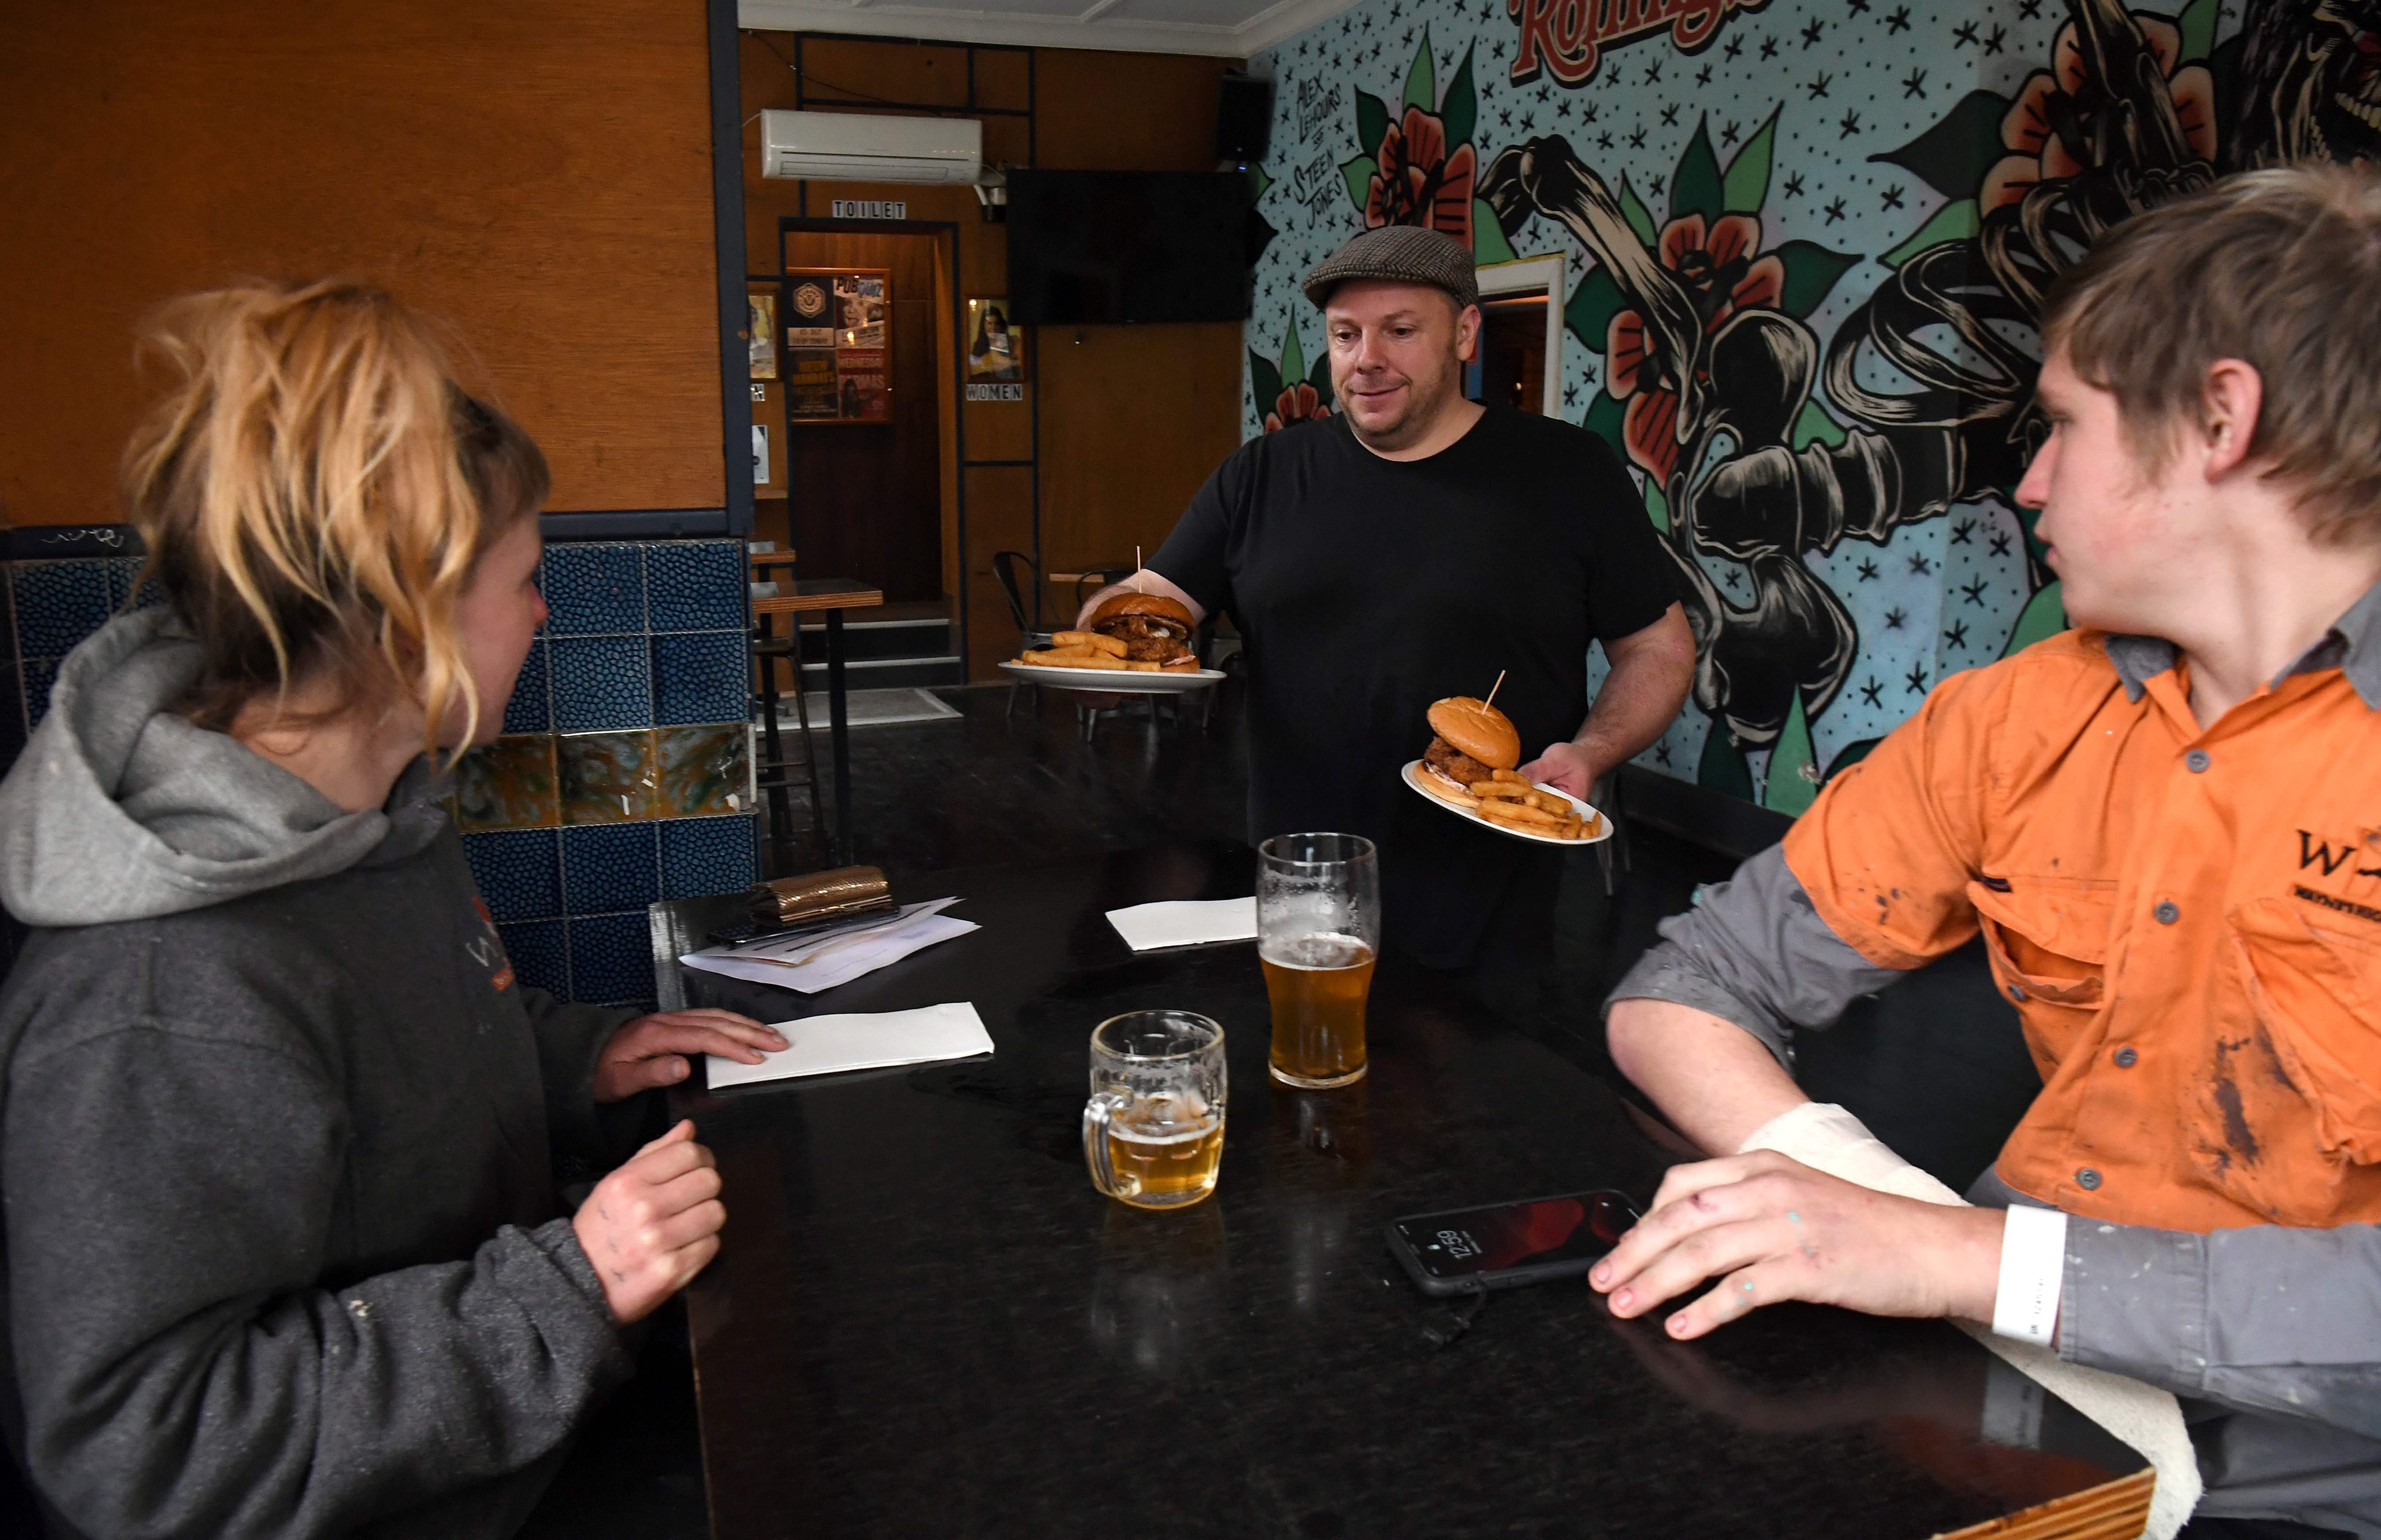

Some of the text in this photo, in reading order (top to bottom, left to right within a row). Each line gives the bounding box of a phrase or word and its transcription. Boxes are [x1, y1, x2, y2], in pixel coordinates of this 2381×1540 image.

[1297, 70, 1324, 118] ALEX
[1294, 145, 1334, 205] STEEN
[835, 201, 904, 218] TOILET
[1304, 173, 1342, 231] JONES
[967, 384, 1021, 399] WOMEN
